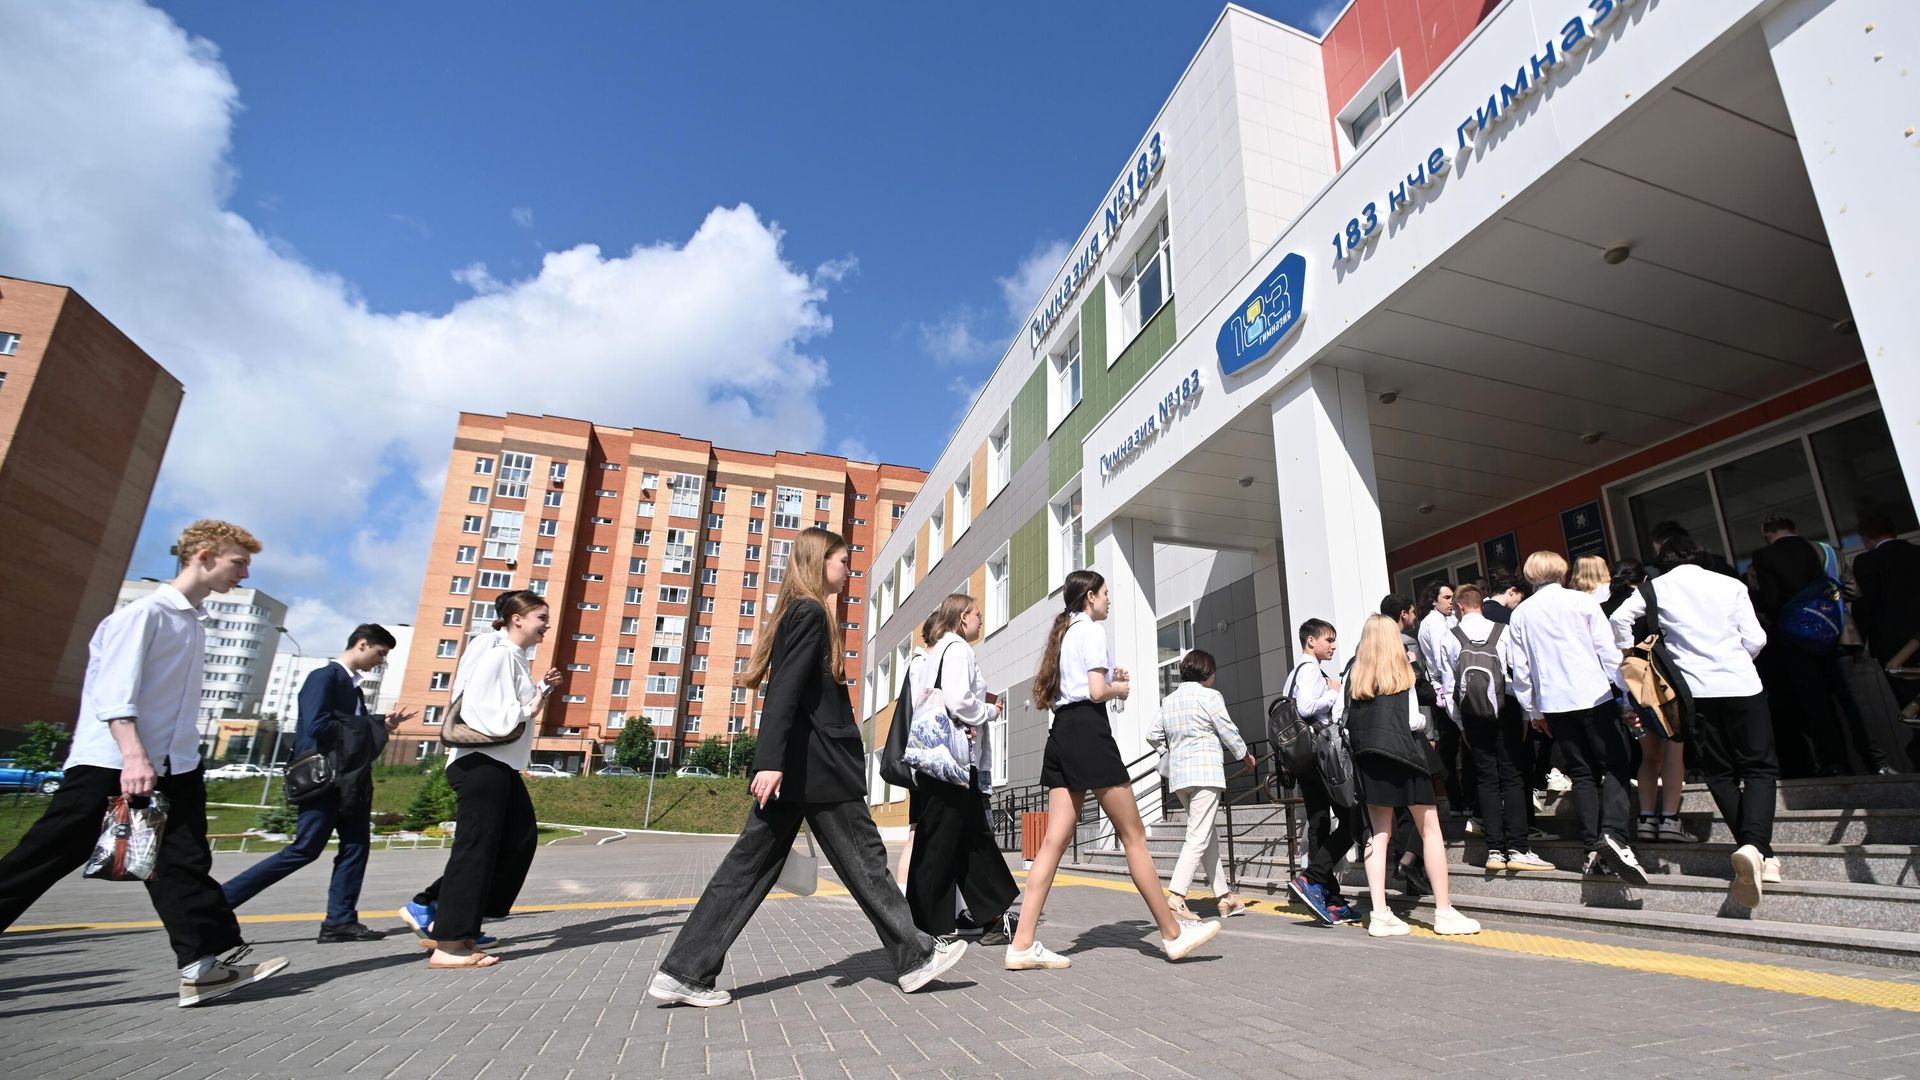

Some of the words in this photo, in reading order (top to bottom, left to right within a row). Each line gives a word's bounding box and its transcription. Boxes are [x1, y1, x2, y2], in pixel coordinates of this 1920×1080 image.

[1333, 202, 1377, 260] 183
[1388, 147, 1445, 212] нче
[1456, 0, 1624, 149] Гимназ
[1030, 231, 1100, 350] Гимназия
[1231, 273, 1291, 357] 183
[1100, 414, 1155, 476] Гимназия
